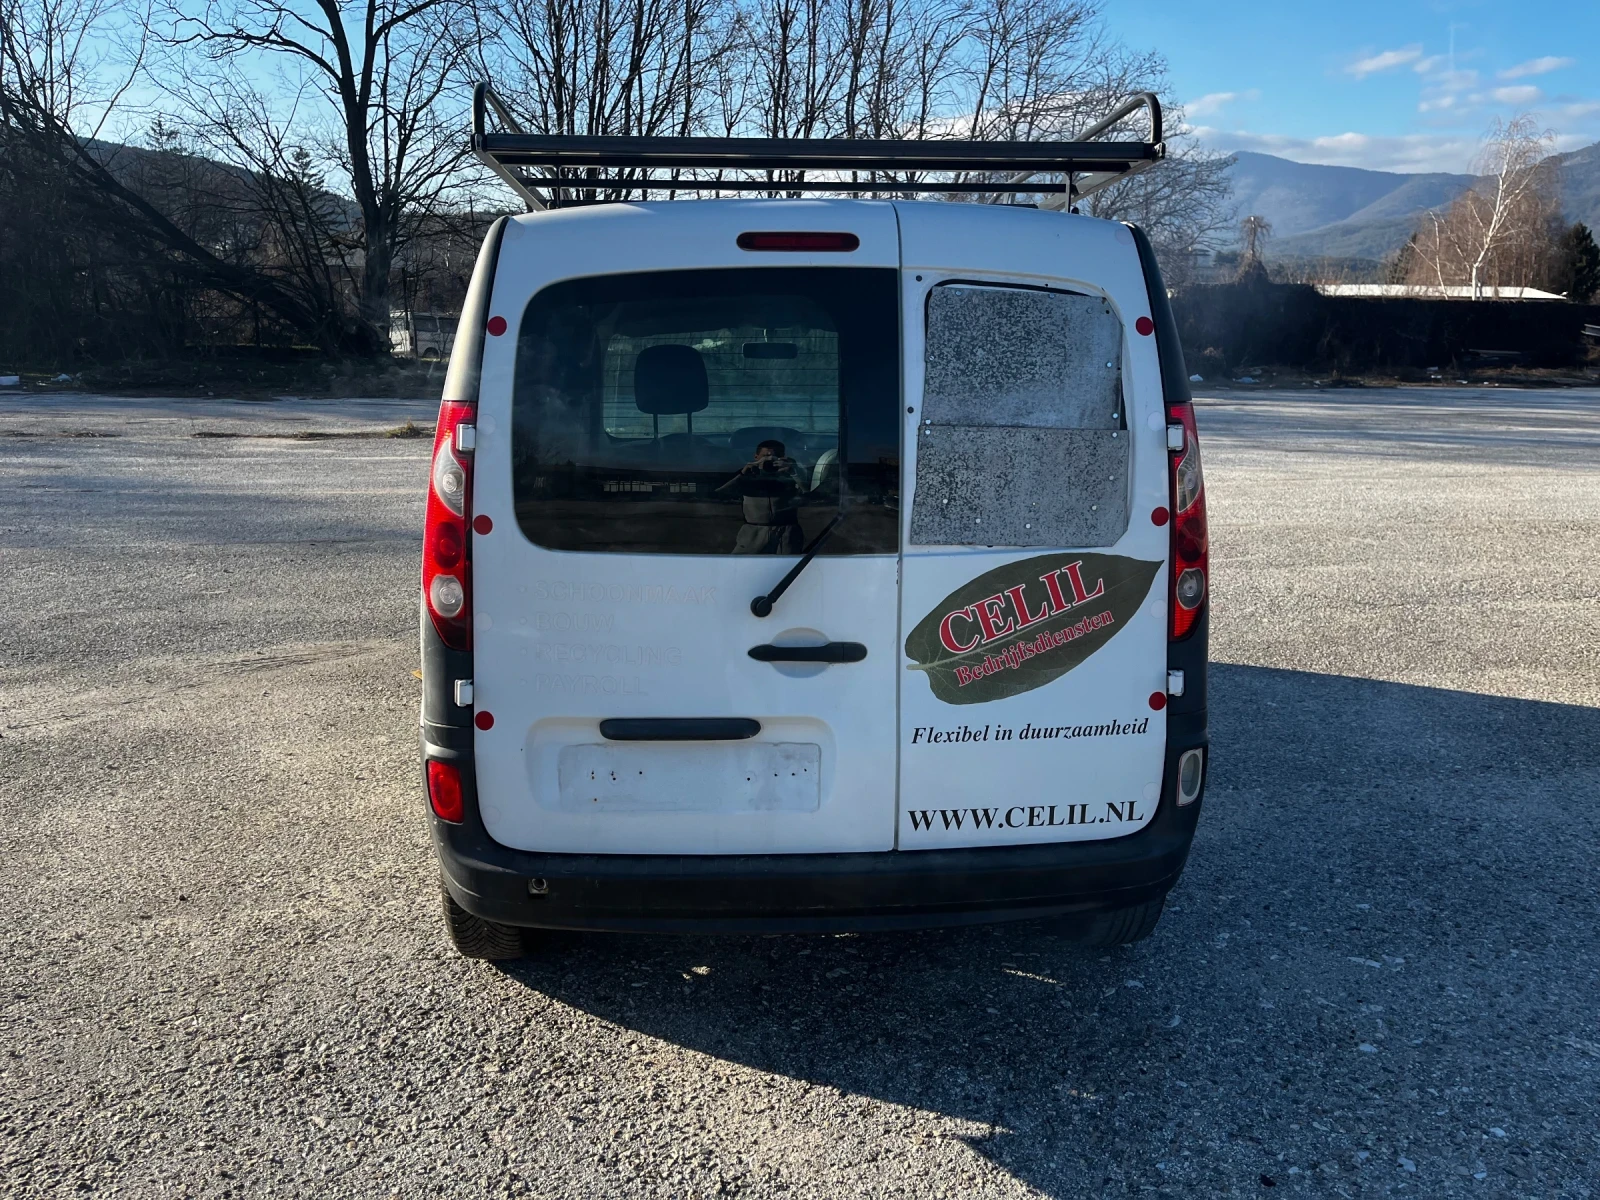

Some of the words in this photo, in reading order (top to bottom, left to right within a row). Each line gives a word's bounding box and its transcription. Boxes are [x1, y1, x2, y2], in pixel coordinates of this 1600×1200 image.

[939, 560, 1105, 654] CELIL
[534, 611, 615, 633] BOUW
[534, 642, 684, 667] RECYCLING
[954, 608, 1114, 687] Bedrijfsdiensten
[535, 673, 649, 696] PAYROLL
[911, 725, 989, 745] Flexibel
[994, 724, 1013, 741] in
[1019, 717, 1149, 741] duurzaamheid
[908, 800, 1144, 832] WWW.CELIL.NL
